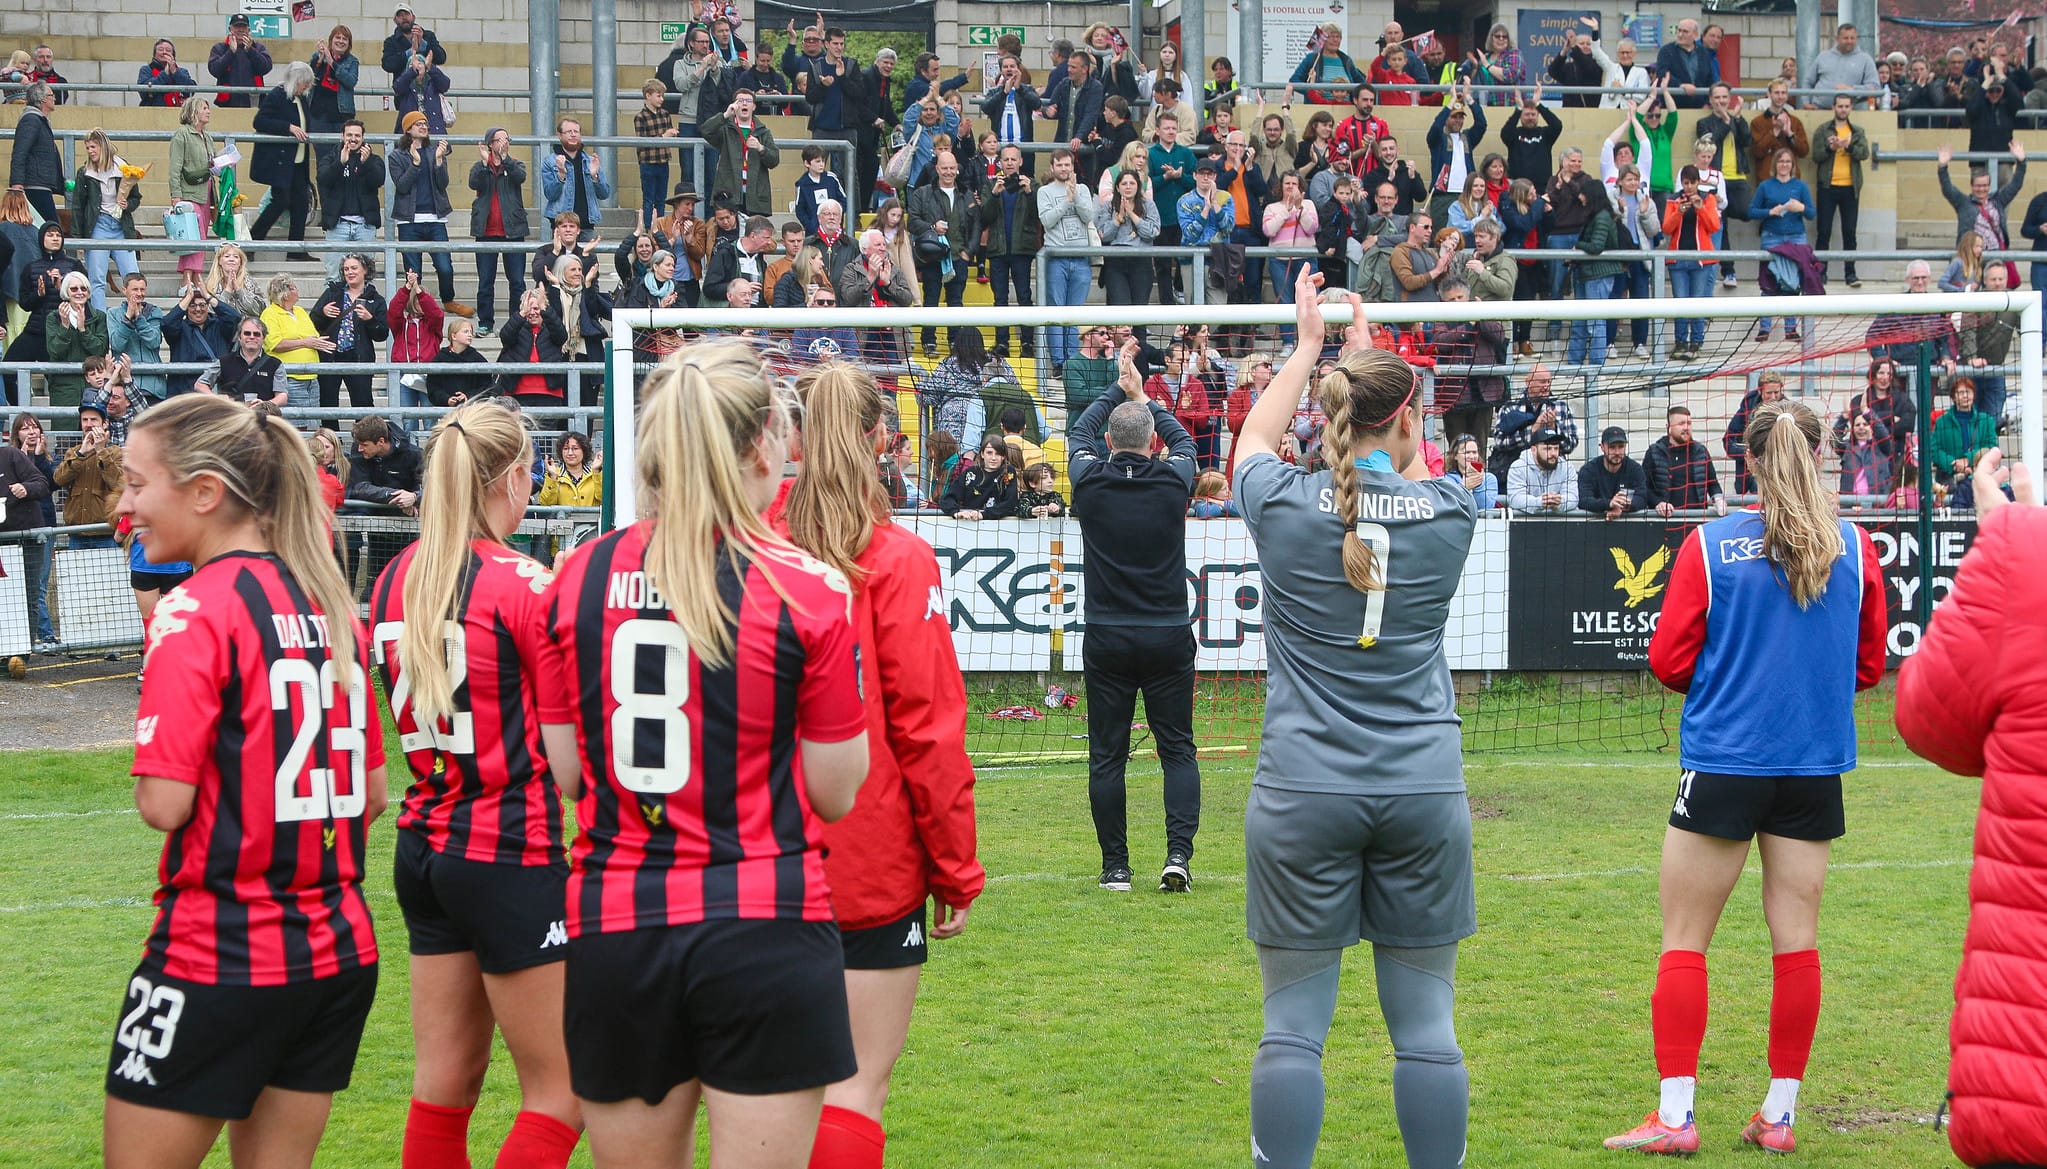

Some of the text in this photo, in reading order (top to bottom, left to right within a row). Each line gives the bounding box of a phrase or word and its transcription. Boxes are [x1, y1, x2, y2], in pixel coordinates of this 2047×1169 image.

[1273, 6, 1306, 14] FOOTBALL
[1540, 16, 1578, 31] simple
[662, 24, 679, 33] Fire
[1529, 34, 1566, 47] SAVIN
[1318, 487, 1435, 520] SNDERS
[607, 570, 673, 610] NOB
[1356, 521, 1391, 638] 7
[1572, 611, 1621, 633] LYLE
[1623, 614, 1636, 633] &
[1614, 638, 1634, 648] EST
[610, 619, 691, 793] 8
[269, 658, 366, 822] 23
[117, 976, 185, 1059] 23
